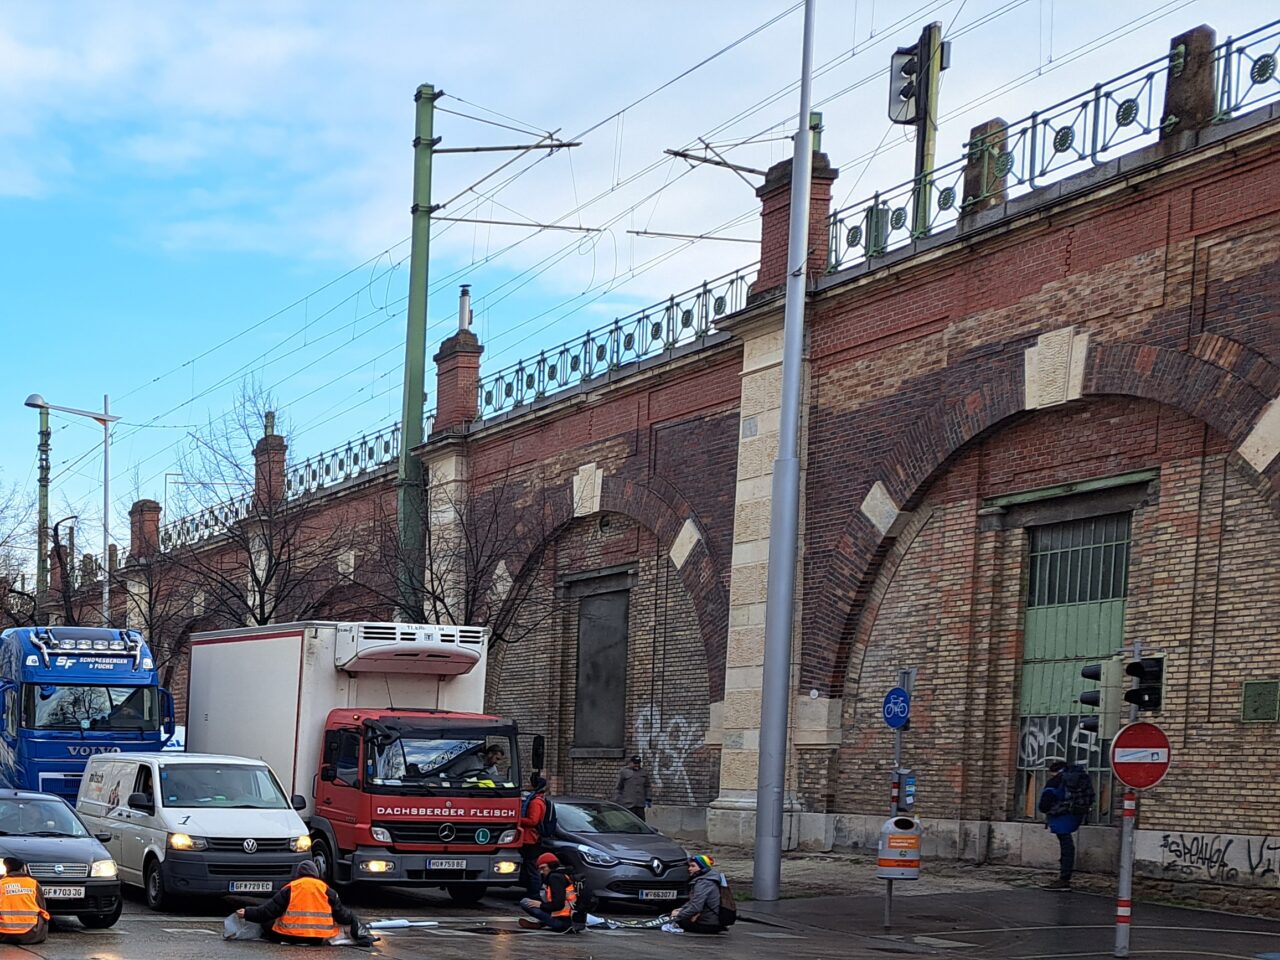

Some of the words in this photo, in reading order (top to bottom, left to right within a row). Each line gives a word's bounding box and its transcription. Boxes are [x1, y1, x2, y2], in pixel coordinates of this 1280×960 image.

[56, 656, 77, 669] SF
[67, 746, 121, 756] VOLVO
[377, 807, 465, 816] DACHSBERGER
[470, 809, 516, 817] FLEISCH
[58, 889, 71, 897] 703
